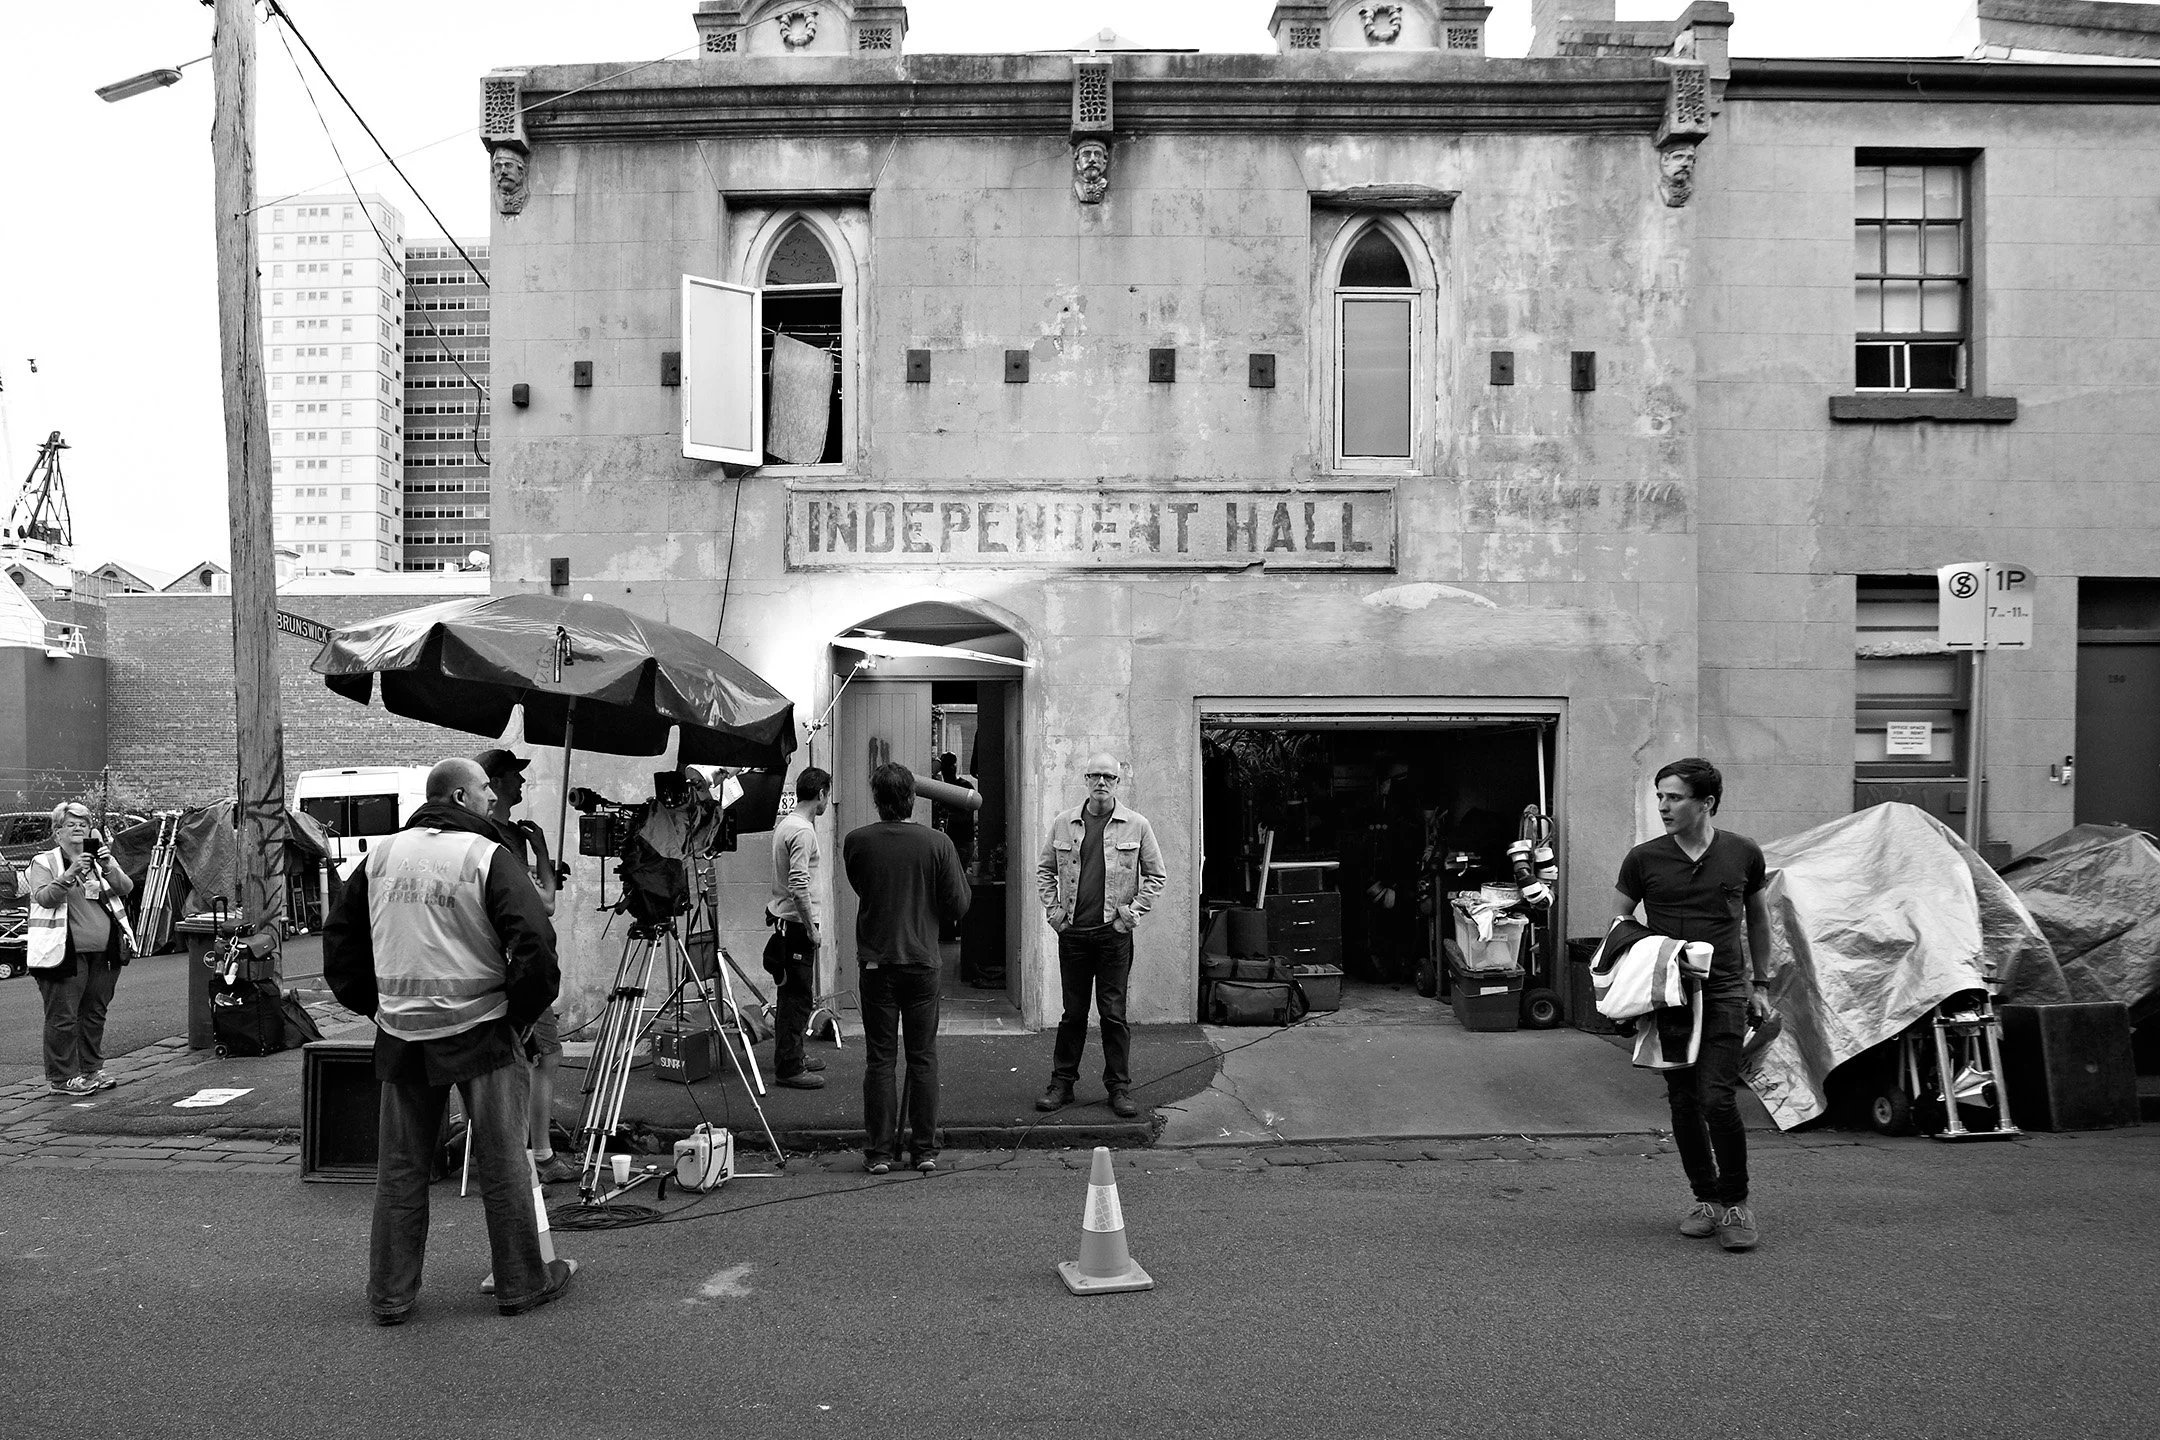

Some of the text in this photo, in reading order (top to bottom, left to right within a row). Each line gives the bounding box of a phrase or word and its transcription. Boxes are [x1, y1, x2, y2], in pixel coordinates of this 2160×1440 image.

[808, 501, 1373, 554] INDEPENDENT HALL
[1996, 570, 2026, 591] 1P
[277, 613, 328, 644] BRUNSWICK
[782, 798, 795, 810] 82
[383, 891, 456, 909] SUPERVISOR
